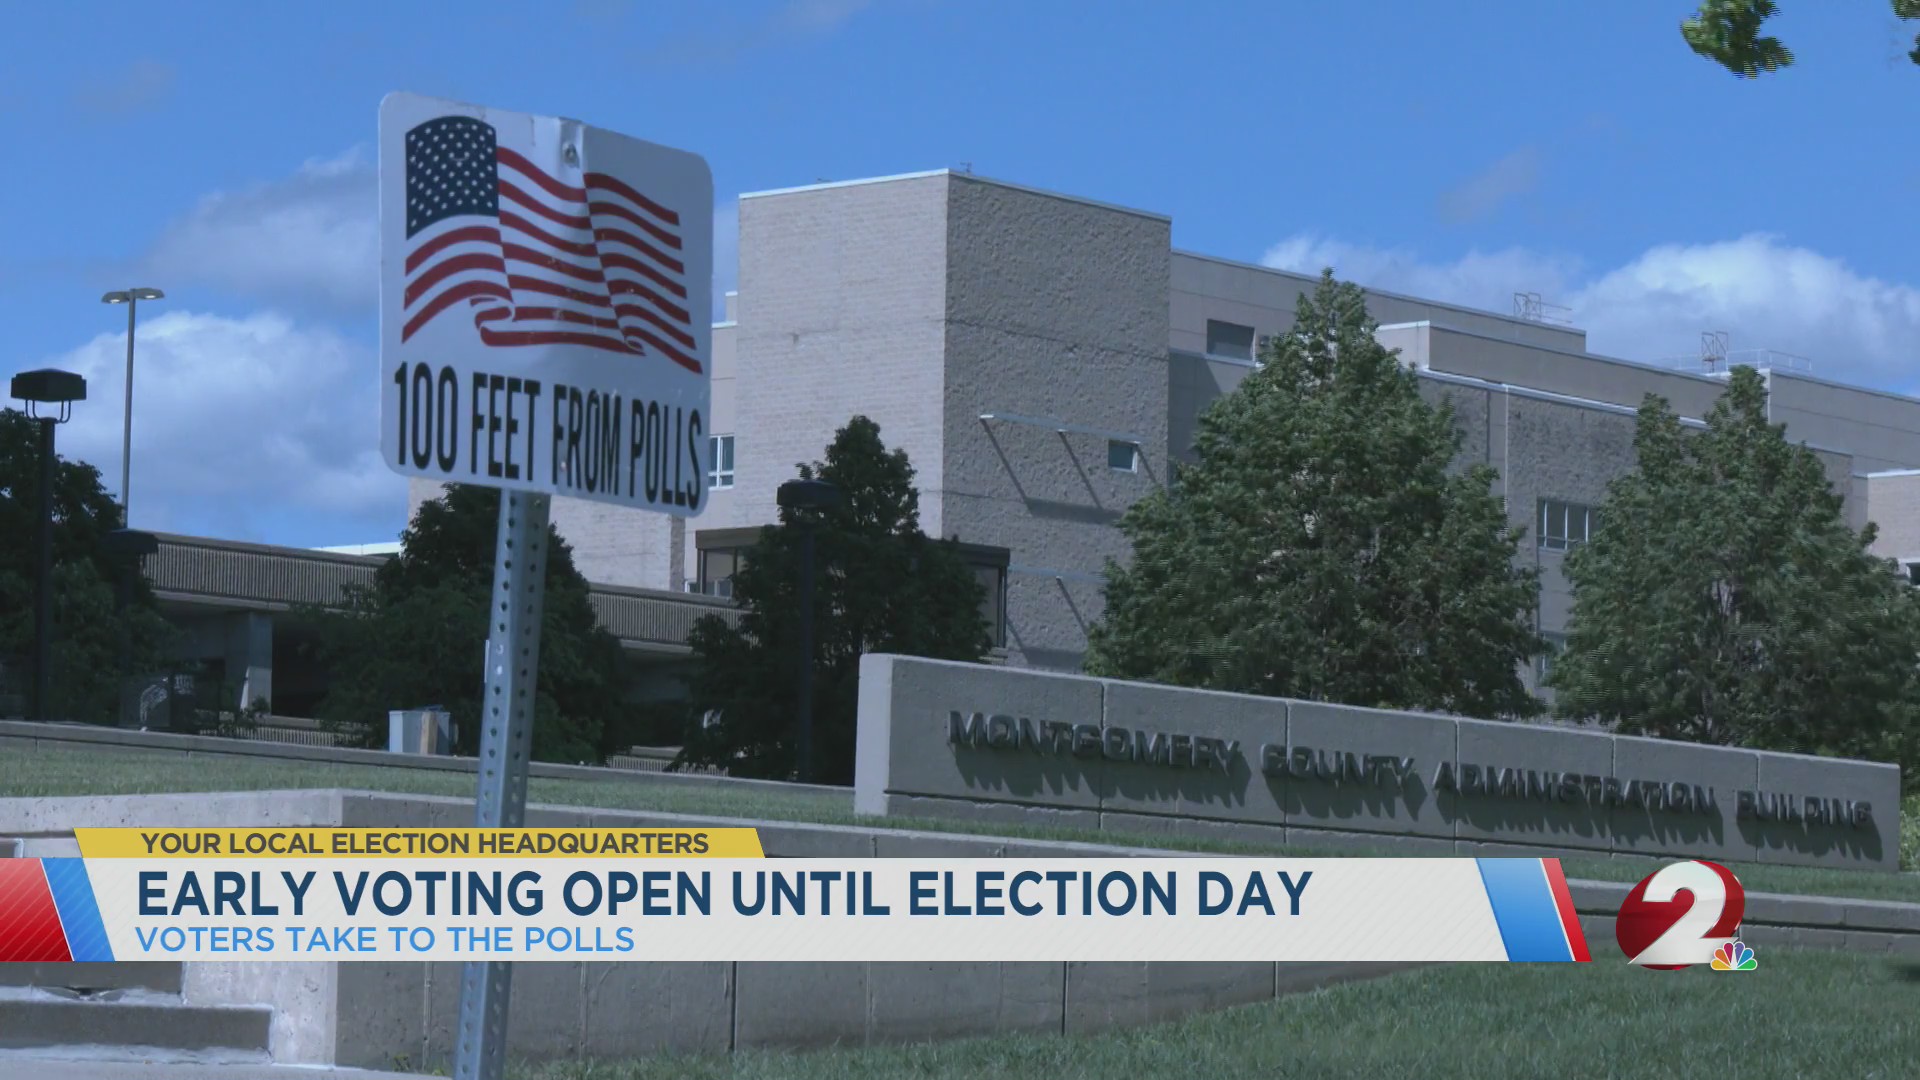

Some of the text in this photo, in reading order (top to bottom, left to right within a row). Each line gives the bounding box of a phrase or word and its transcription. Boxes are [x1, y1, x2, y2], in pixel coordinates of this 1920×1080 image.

[394, 361, 702, 511] 100 FEET FROM POLLS
[949, 710, 1873, 826] MONTGOMERY COUNTY ADMINISTRATION BUILDING
